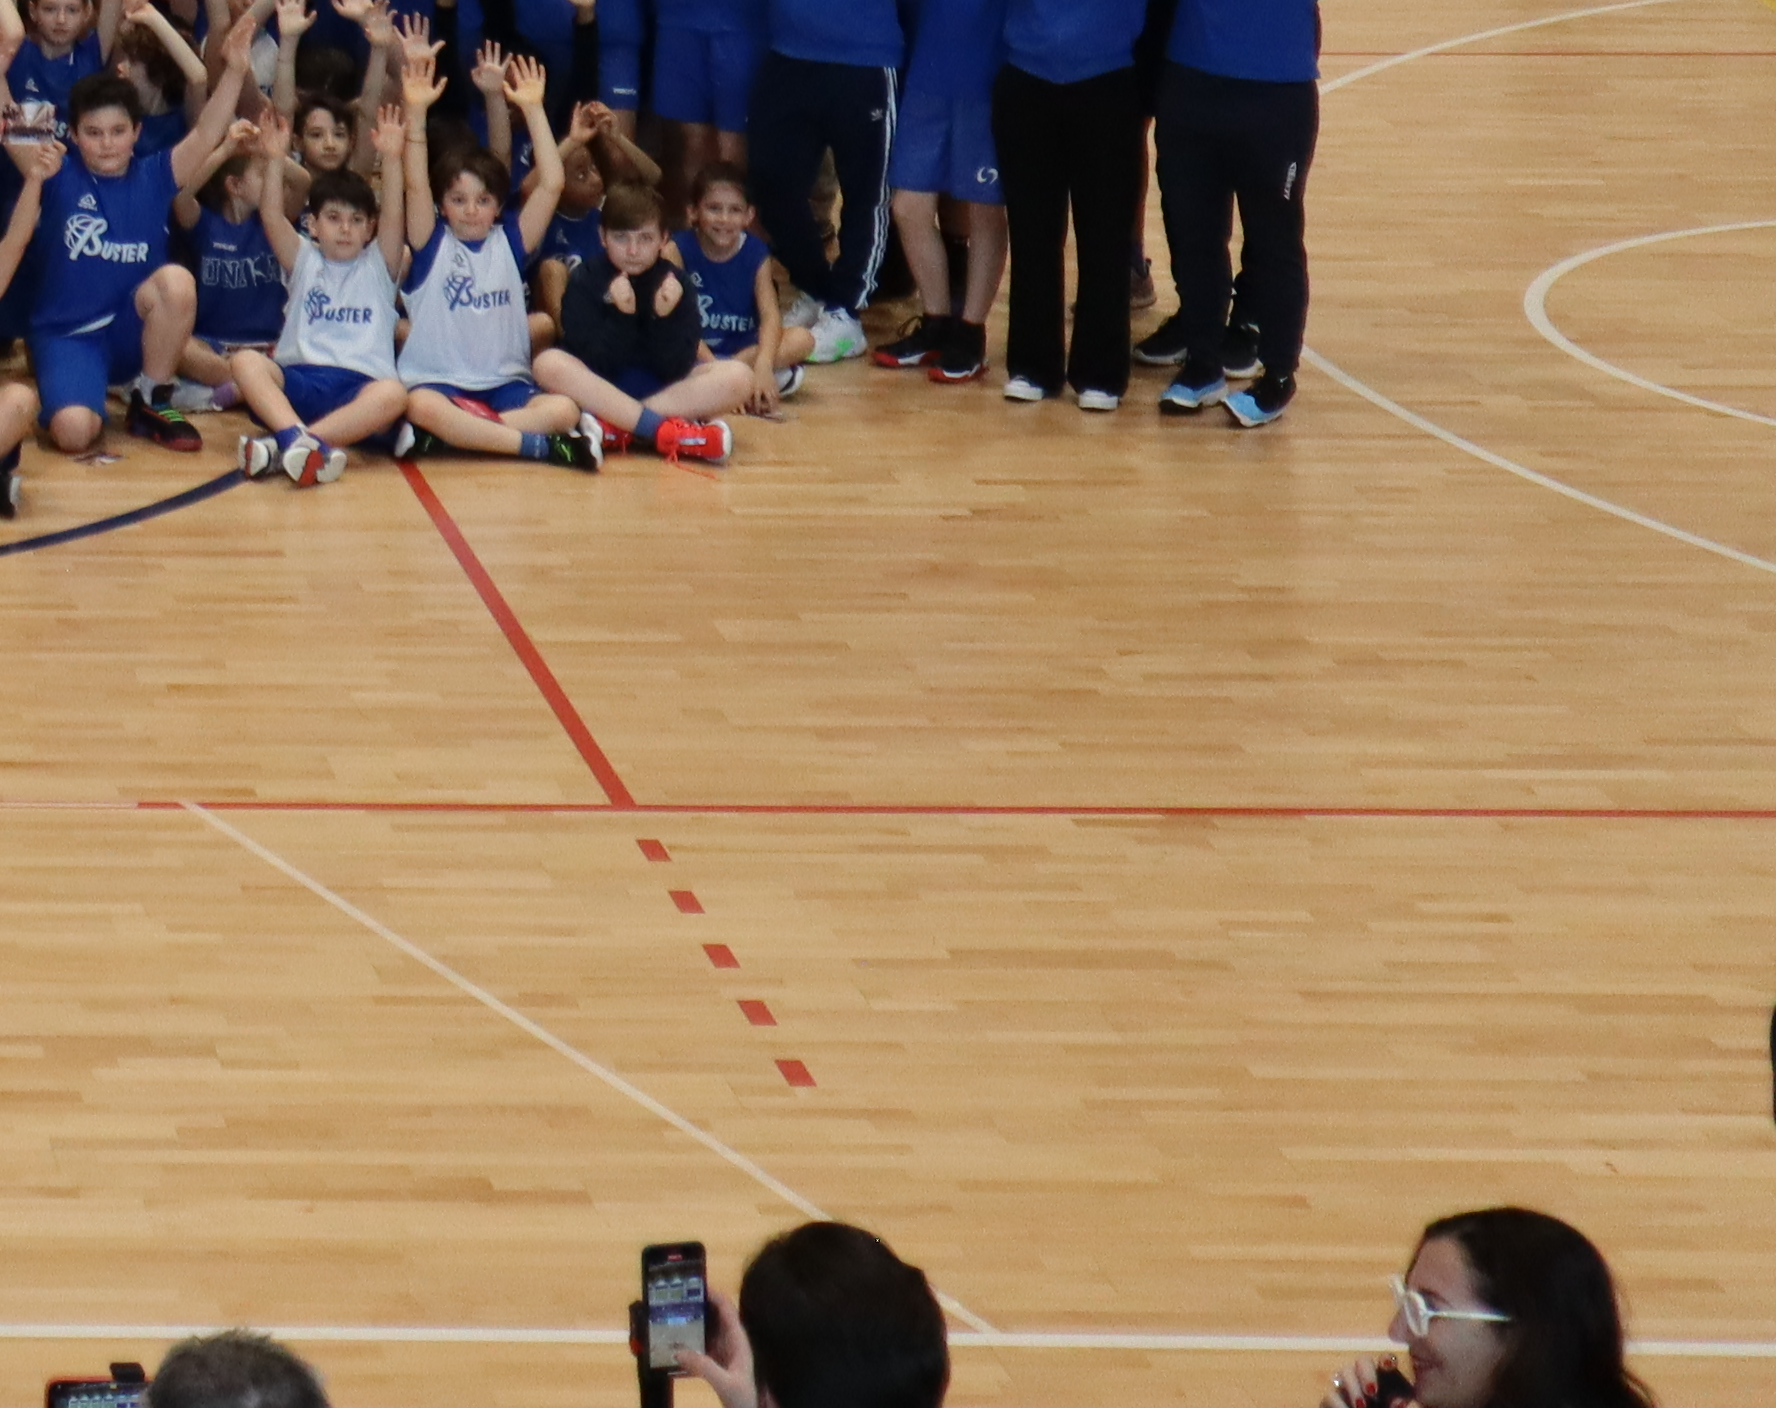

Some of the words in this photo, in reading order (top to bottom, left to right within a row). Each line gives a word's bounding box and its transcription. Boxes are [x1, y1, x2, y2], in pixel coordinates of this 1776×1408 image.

[72, 217, 148, 262] BUSTER
[310, 289, 373, 325] BUSTER
[451, 276, 511, 311] BUSTER
